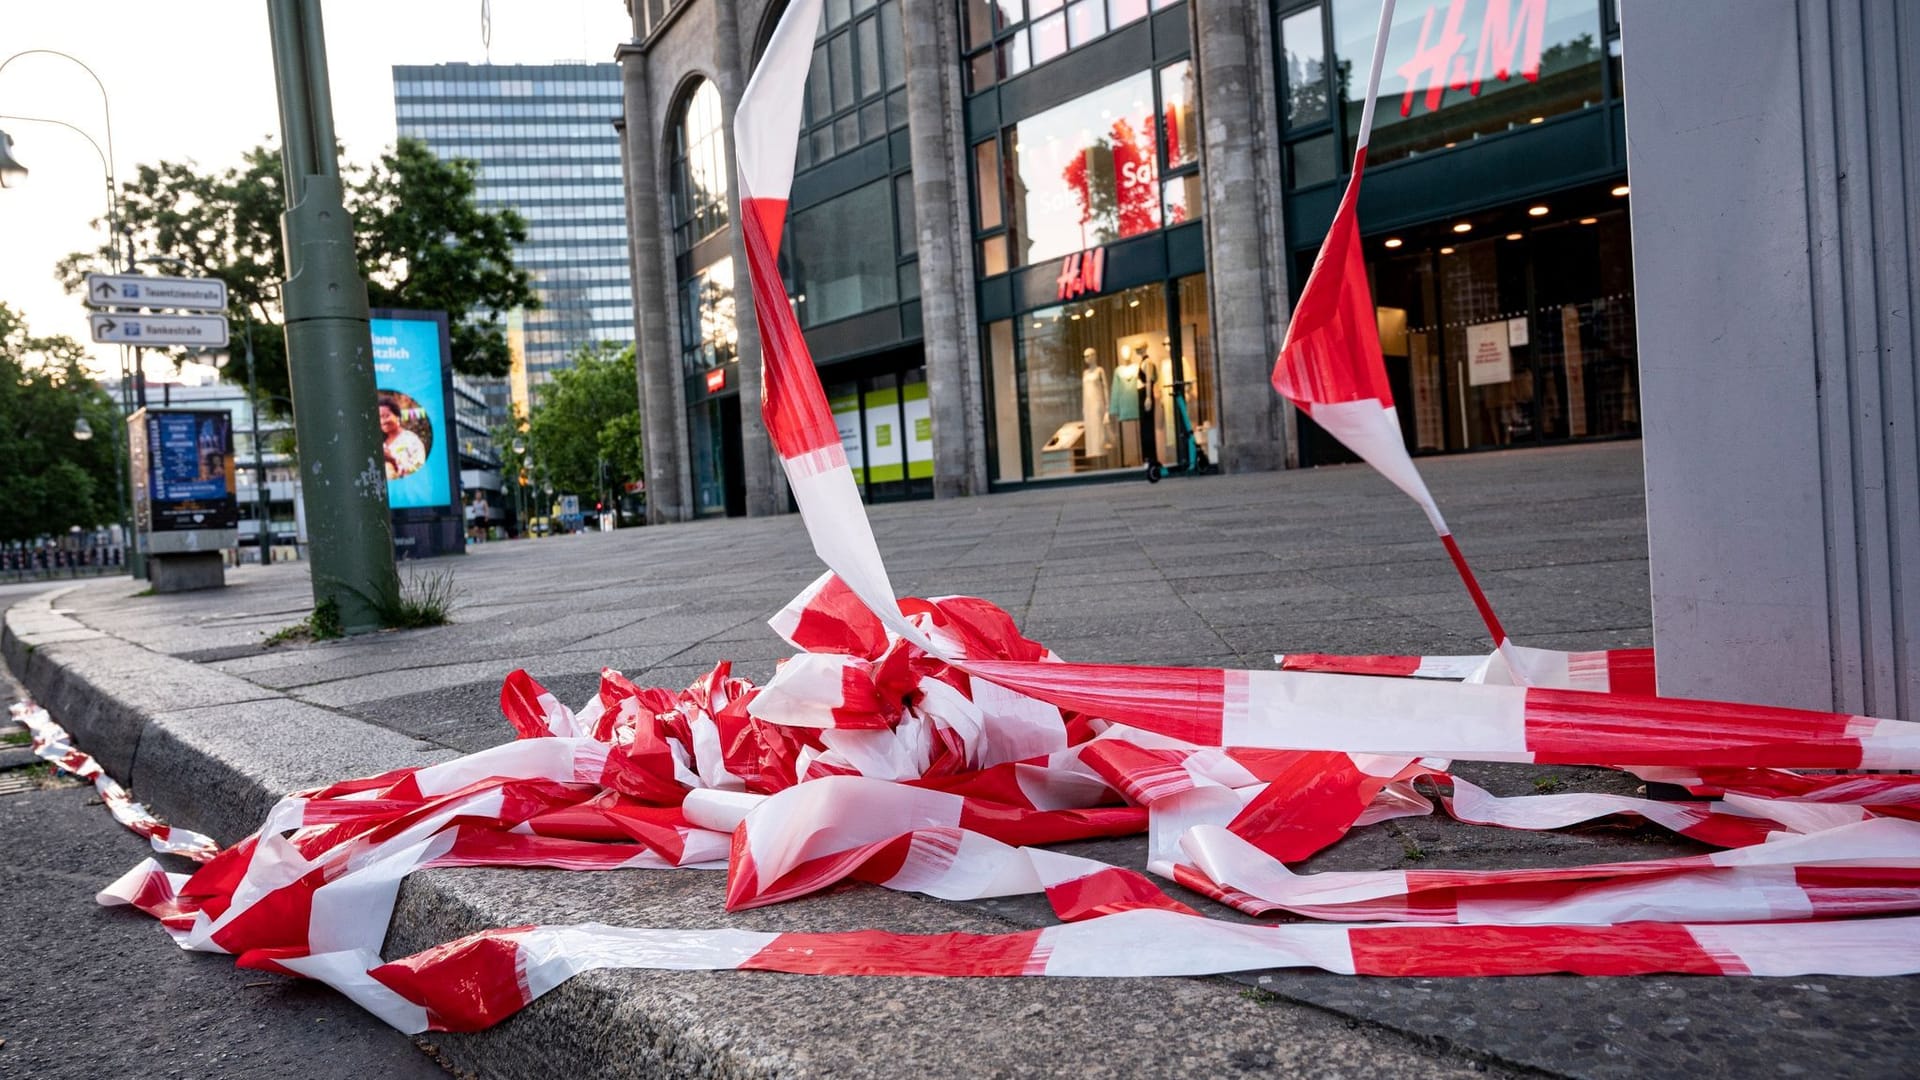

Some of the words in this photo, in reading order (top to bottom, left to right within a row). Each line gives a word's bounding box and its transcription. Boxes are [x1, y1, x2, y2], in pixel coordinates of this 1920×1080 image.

[1397, 0, 1547, 117] H&M
[1122, 154, 1158, 189] Sal
[1057, 246, 1105, 300] H&M
